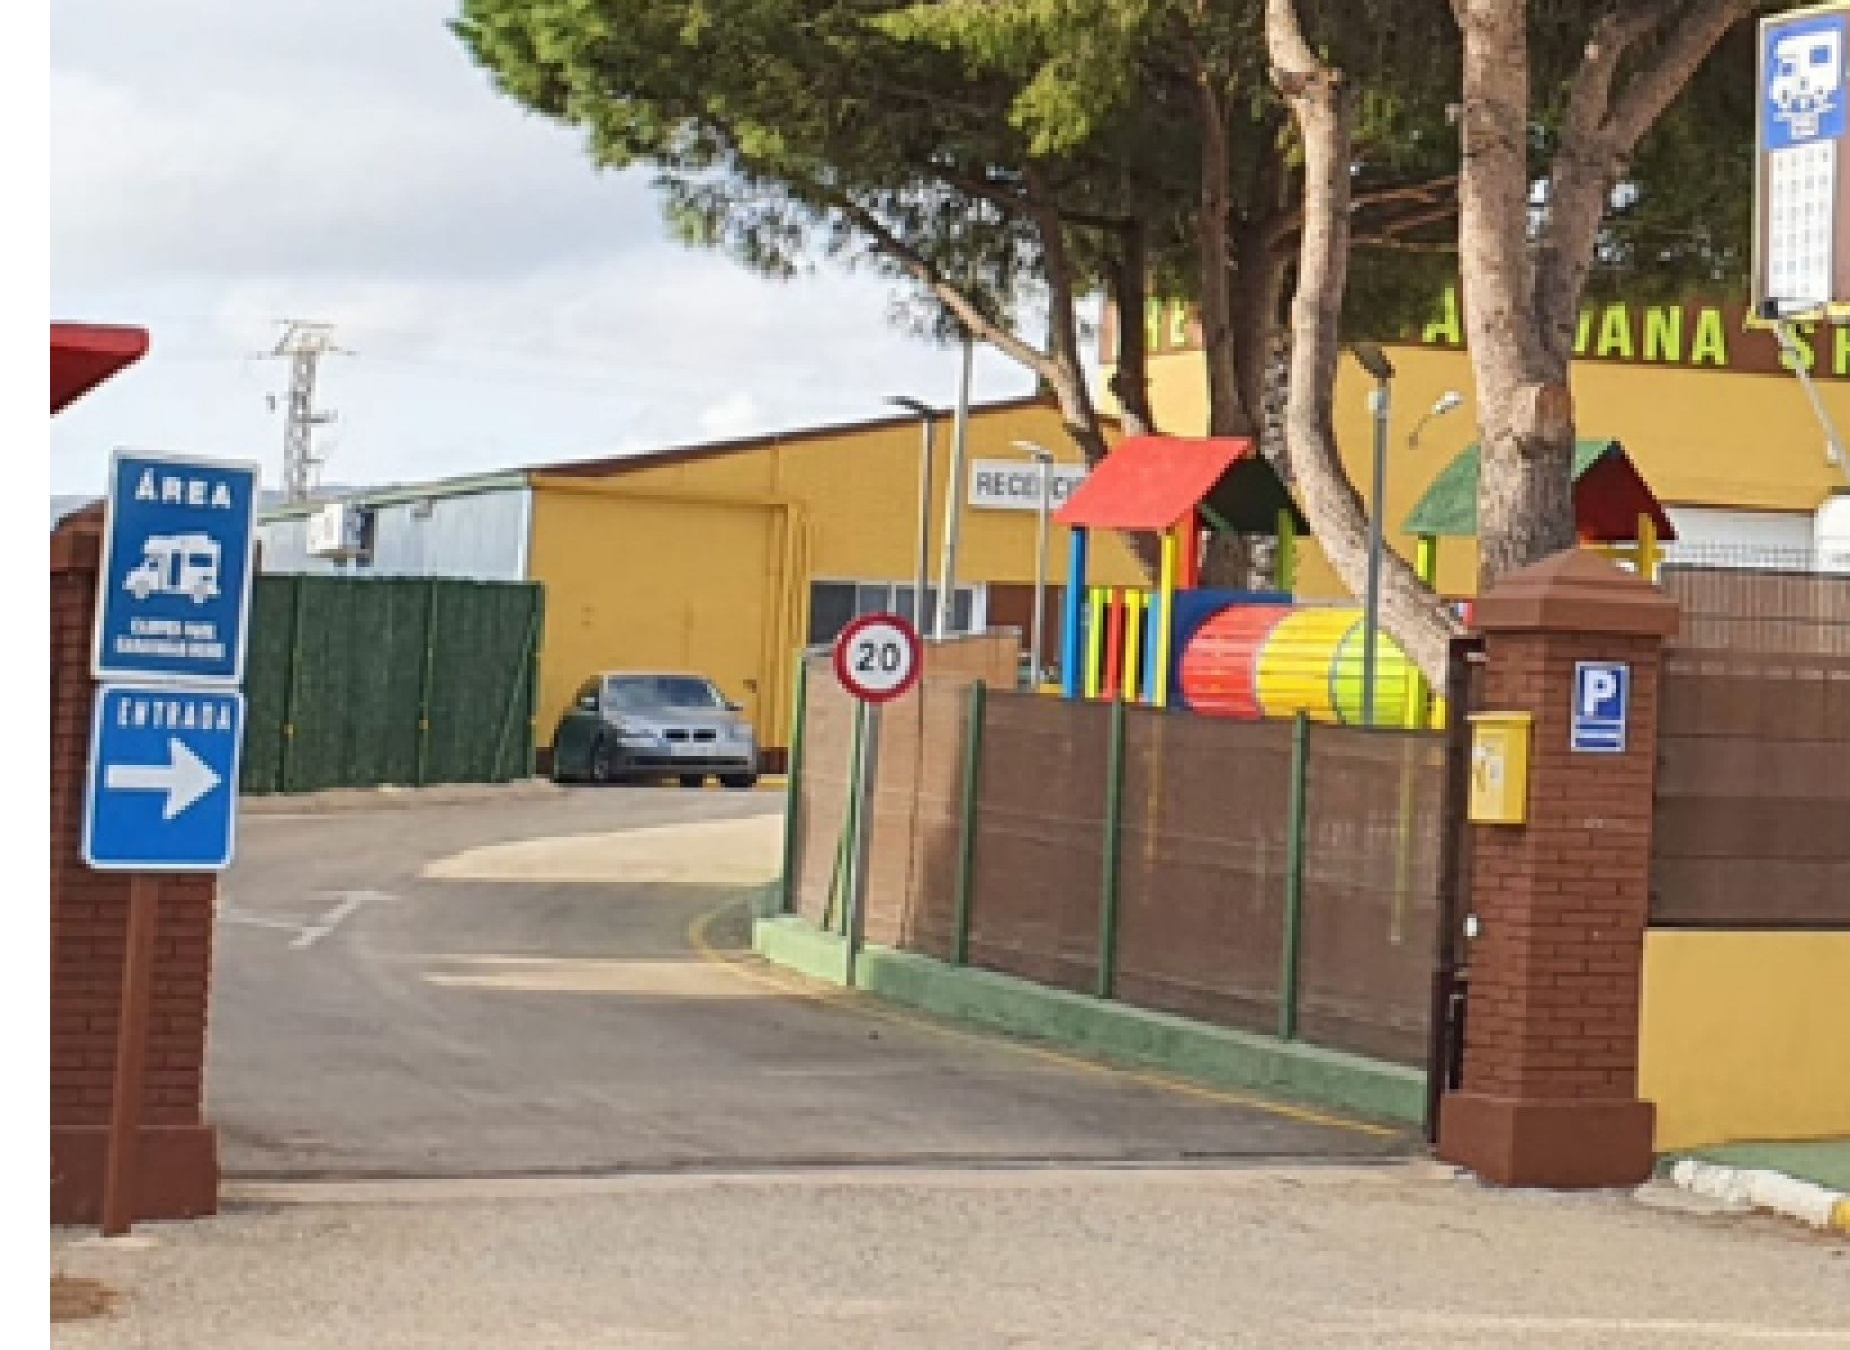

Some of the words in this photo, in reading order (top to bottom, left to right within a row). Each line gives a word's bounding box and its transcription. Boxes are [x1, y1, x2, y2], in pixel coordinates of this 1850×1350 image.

[134, 467, 233, 510] ÁREA
[855, 640, 901, 672] 20
[1582, 668, 1617, 714] P
[117, 697, 232, 731] ENTRADA
